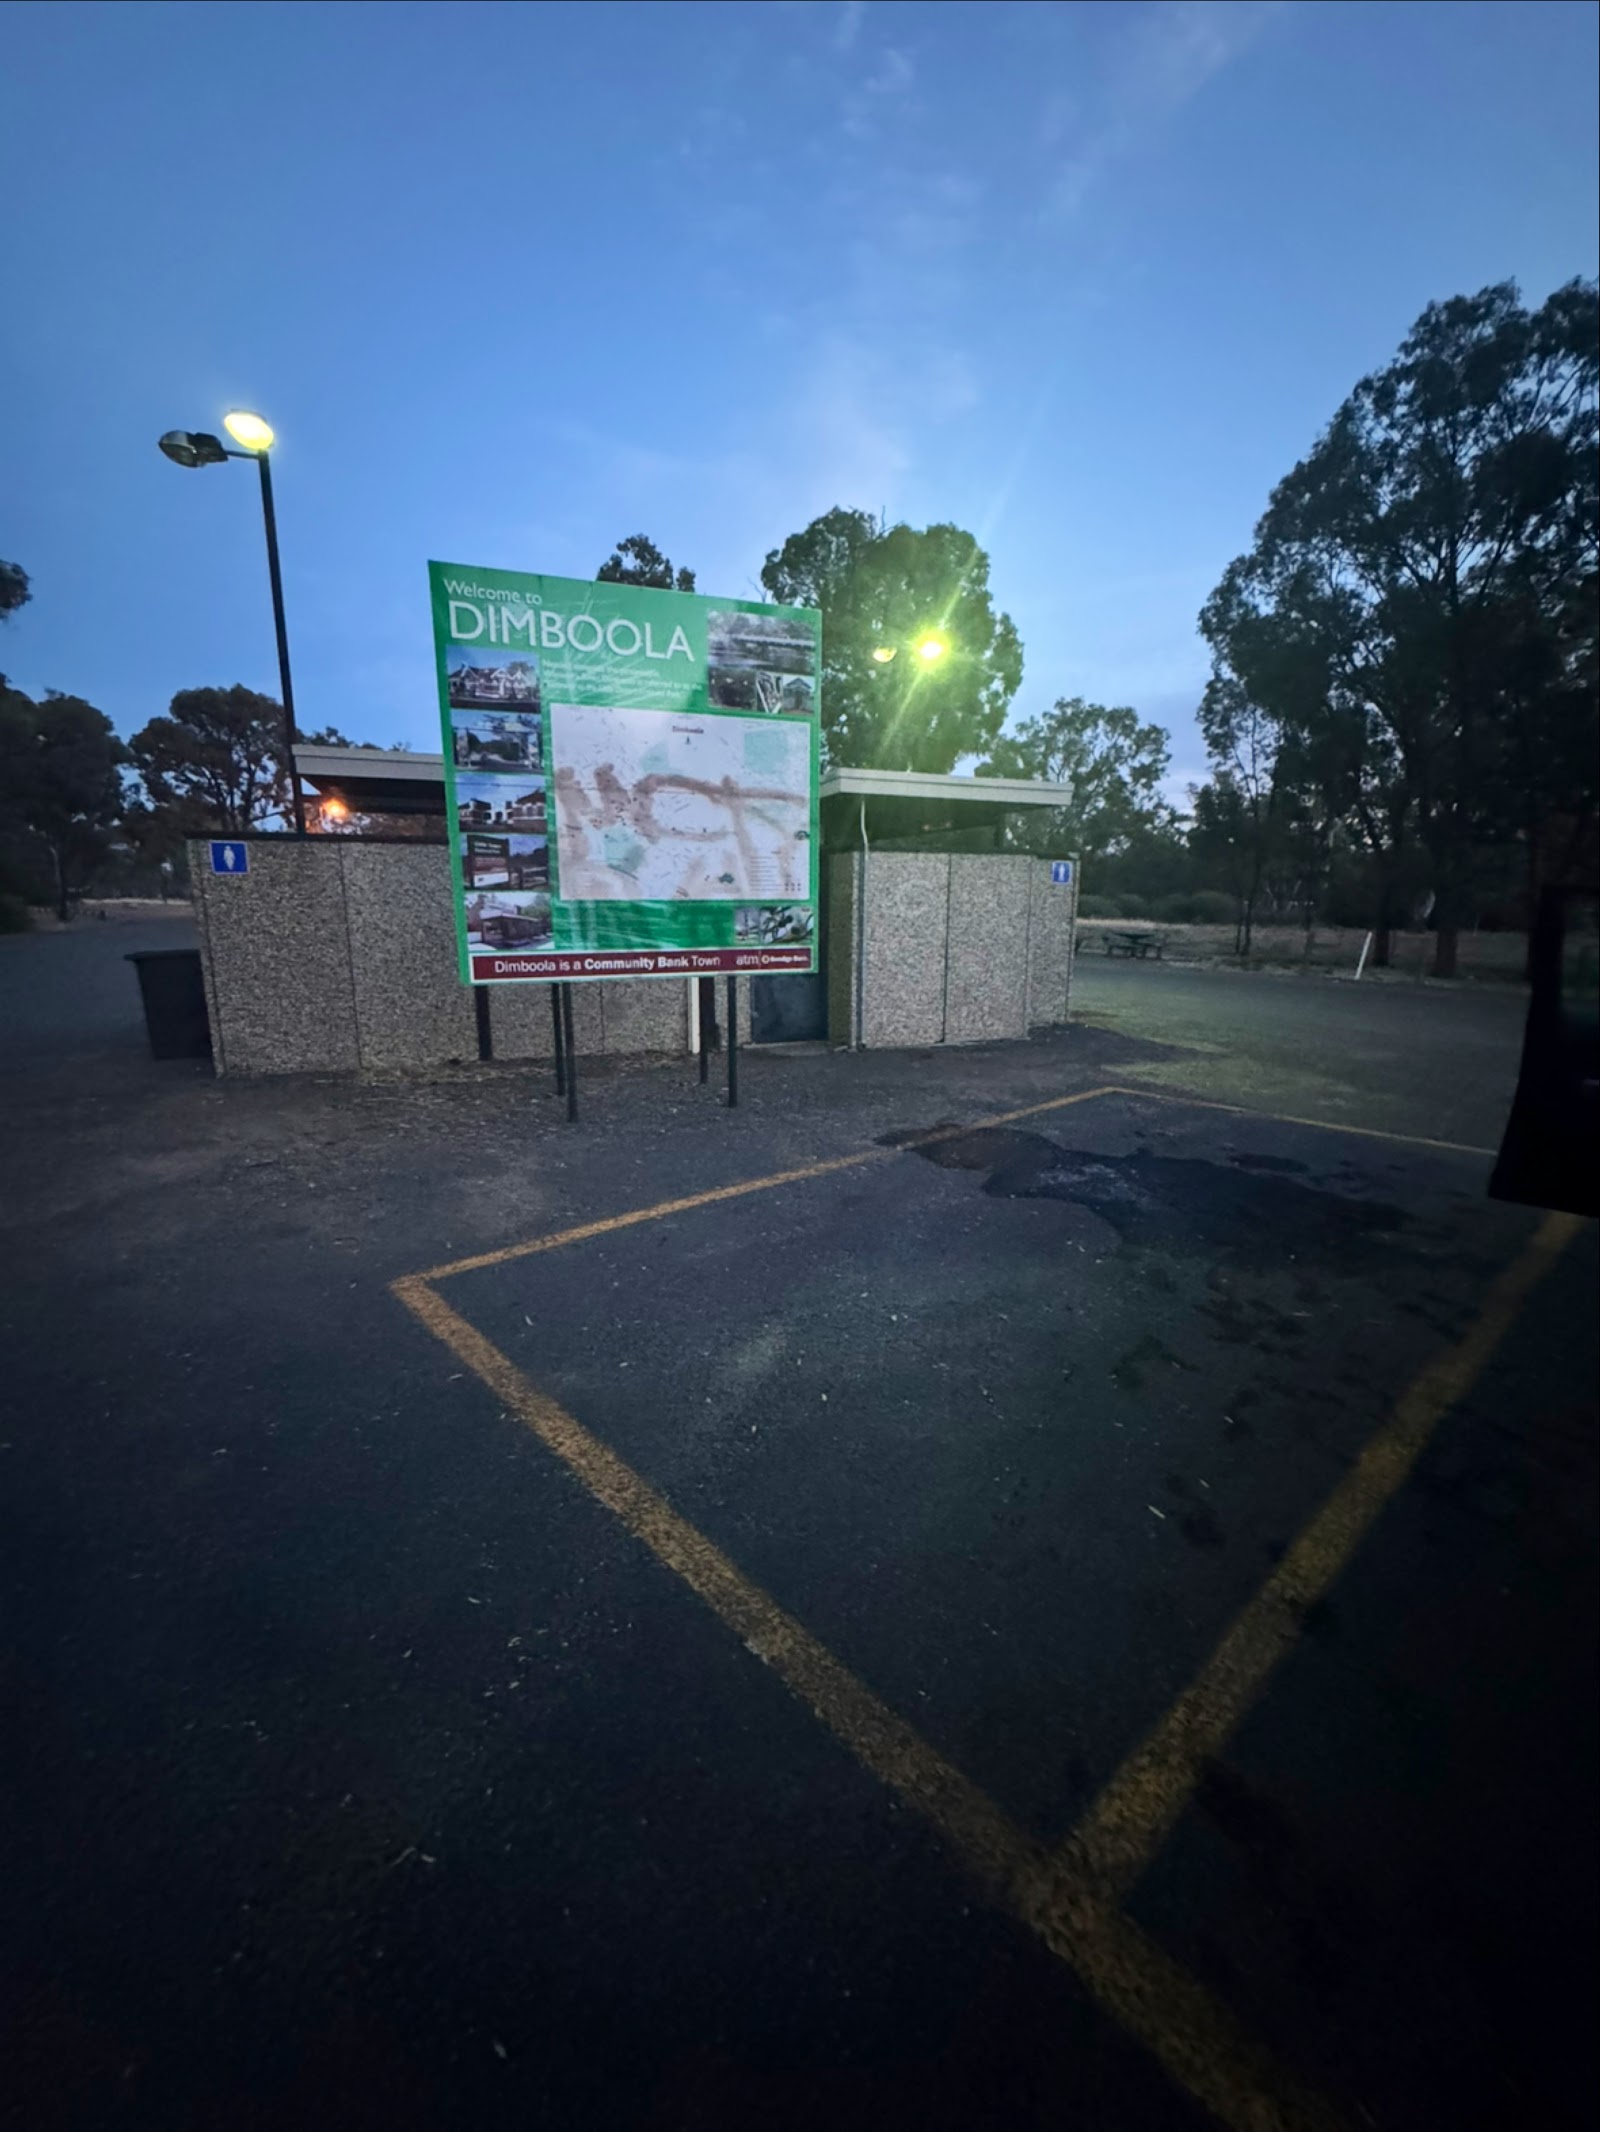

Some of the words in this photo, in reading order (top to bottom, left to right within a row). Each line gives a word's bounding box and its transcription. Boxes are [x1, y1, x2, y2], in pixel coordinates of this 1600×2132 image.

[444, 579, 520, 603] Welcome
[526, 592, 543, 605] to
[450, 600, 695, 662] DIMBOOLA
[495, 960, 556, 973] Dimboola
[559, 959, 570, 971] is
[573, 961, 581, 970] a
[584, 956, 655, 970] Community
[657, 956, 689, 967] Bank
[691, 954, 721, 966] Town
[736, 954, 759, 966] atm
